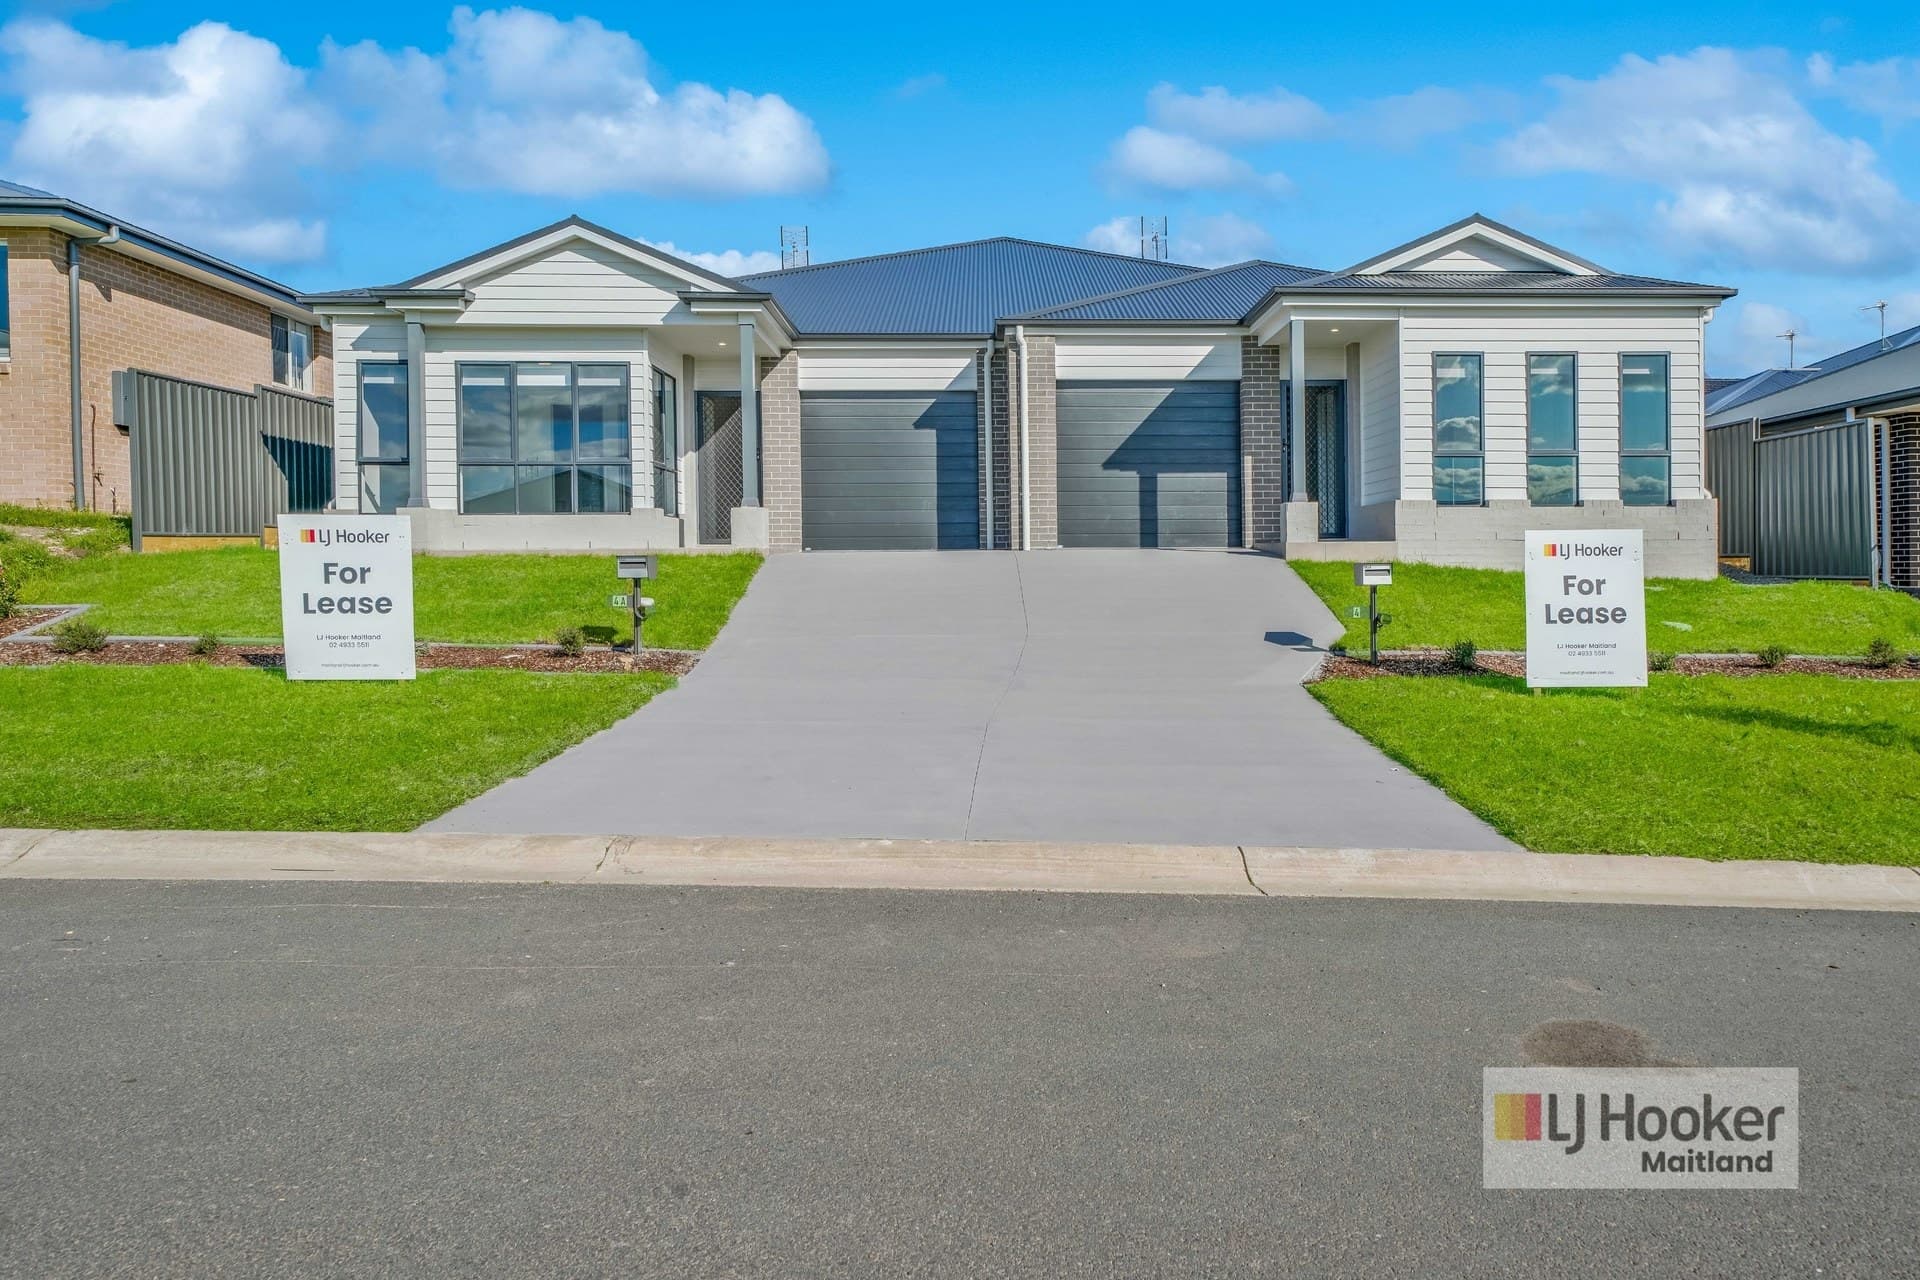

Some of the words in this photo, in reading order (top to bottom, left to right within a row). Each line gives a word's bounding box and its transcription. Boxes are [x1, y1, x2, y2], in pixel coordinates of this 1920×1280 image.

[319, 529, 330, 547] LJ
[336, 529, 390, 544] Hooker
[1560, 543, 1570, 560] LJ
[1574, 543, 1623, 557] Hooker
[323, 562, 372, 585] For
[1563, 575, 1606, 596] For
[303, 592, 393, 614] Lease
[614, 596, 626, 606] 4A
[1545, 603, 1627, 625] Lease
